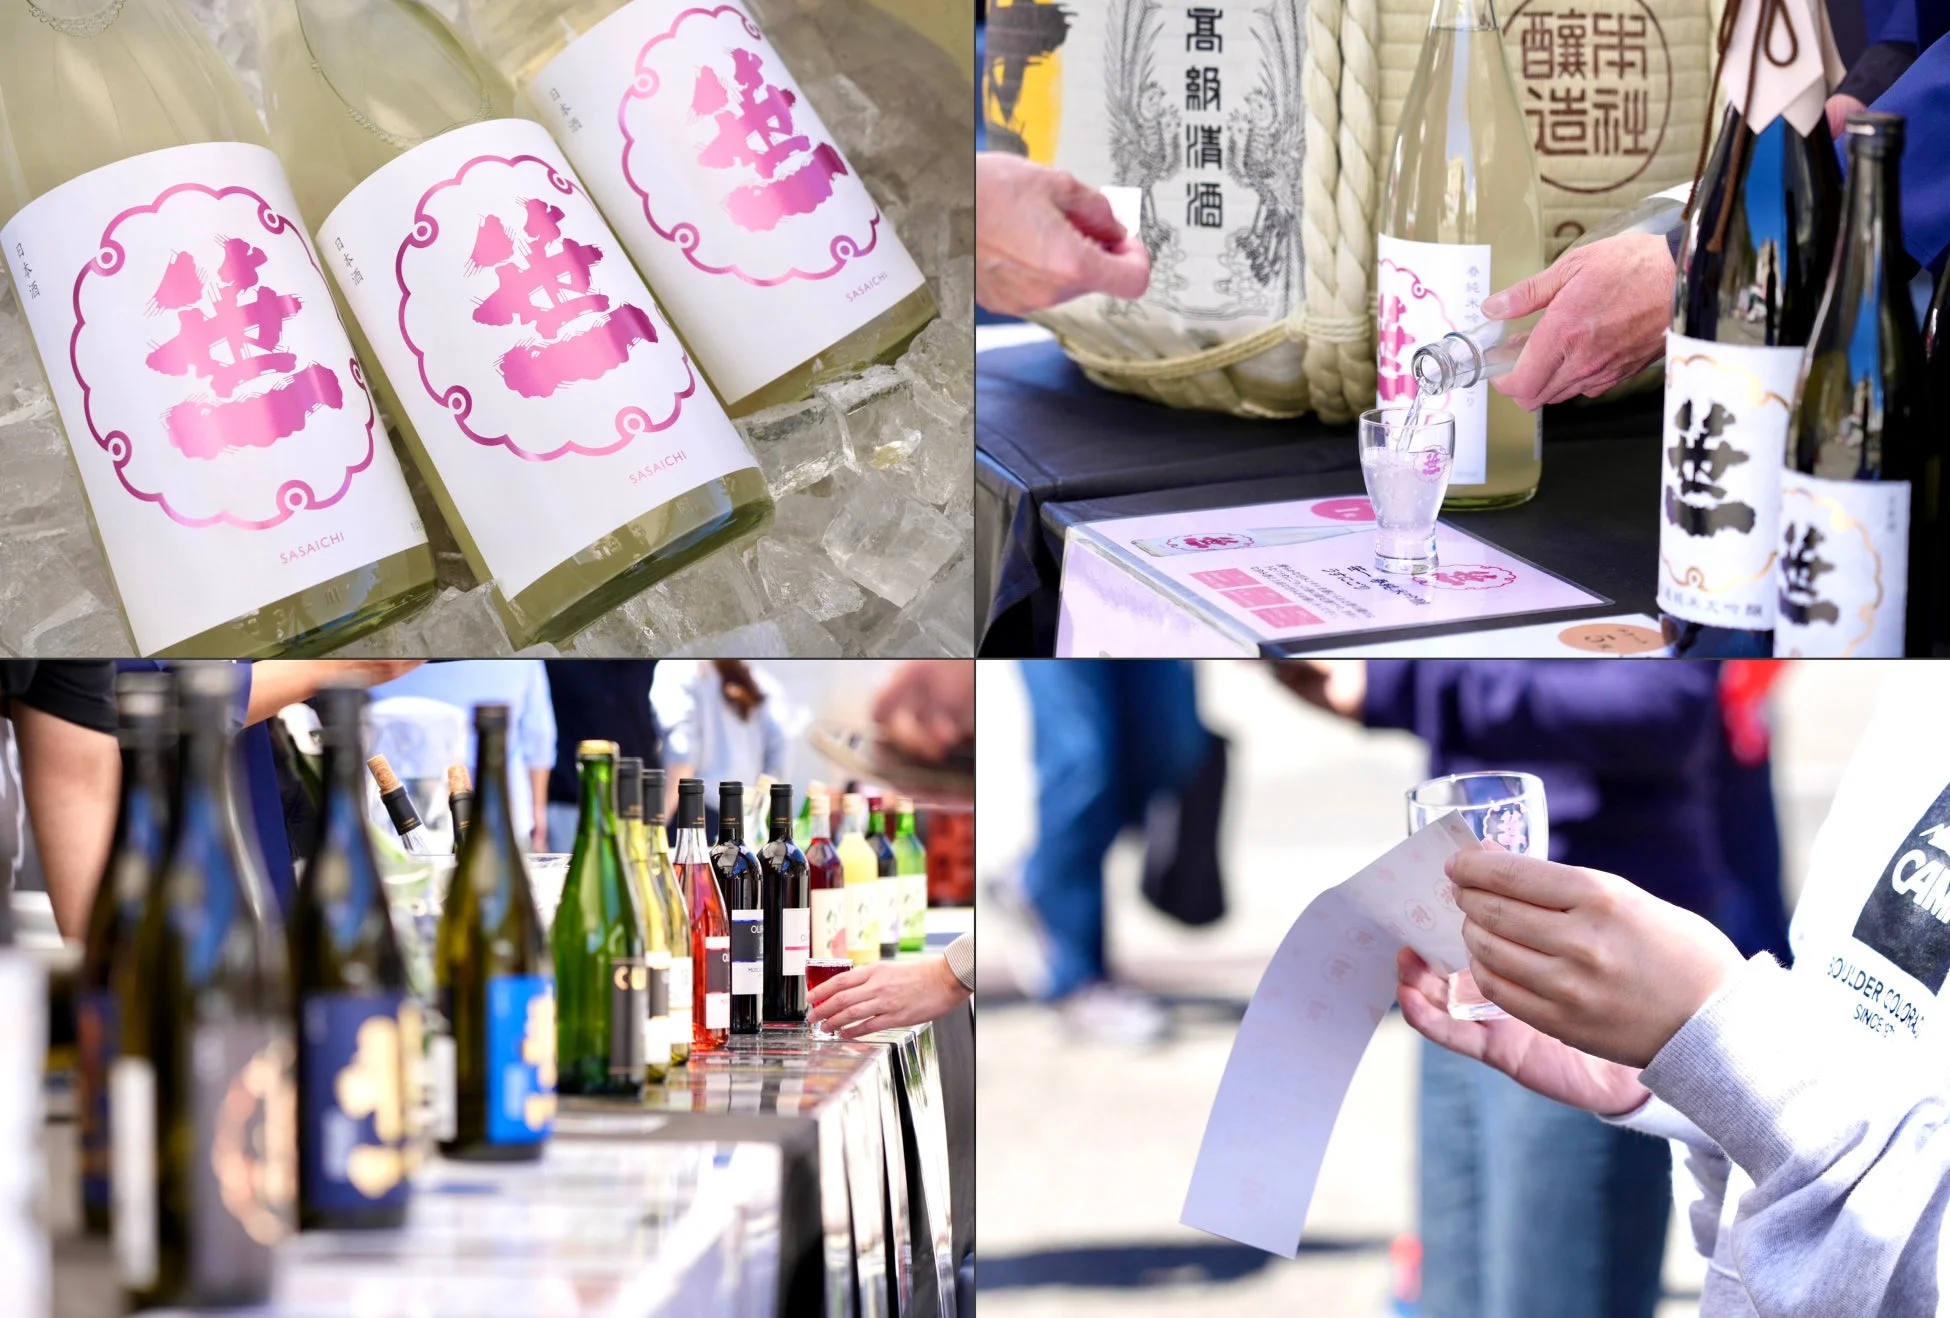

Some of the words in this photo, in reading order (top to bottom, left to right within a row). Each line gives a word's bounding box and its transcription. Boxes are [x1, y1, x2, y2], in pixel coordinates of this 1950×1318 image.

[15, 242, 41, 300] 日本酒
[334, 236, 364, 287] 日本酒
[845, 271, 889, 303] SASAICHI
[628, 450, 688, 485] SASAICHI
[279, 531, 345, 565] SASAICHI
[1853, 1003, 1884, 1032] SINCE
